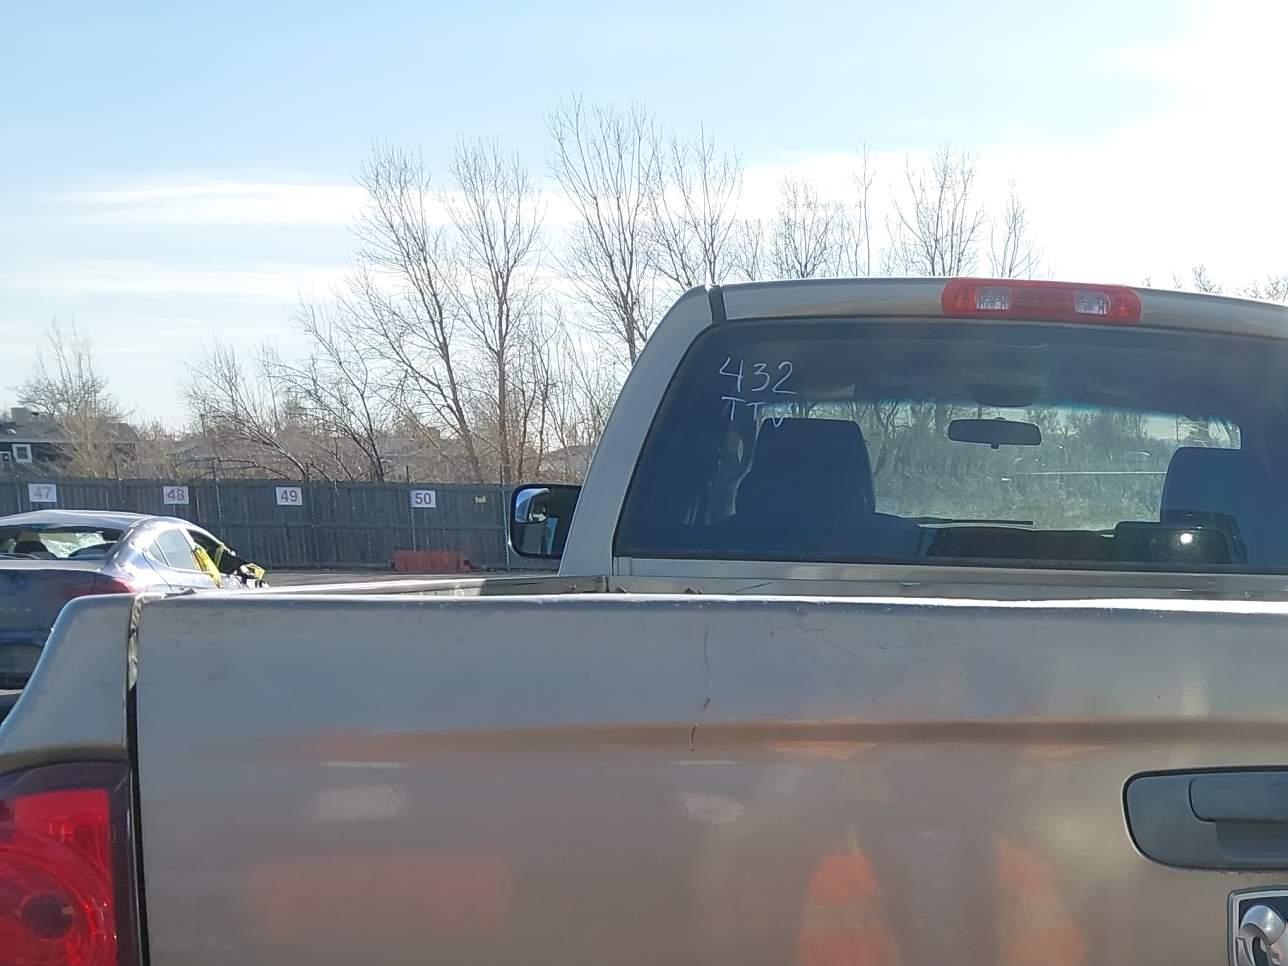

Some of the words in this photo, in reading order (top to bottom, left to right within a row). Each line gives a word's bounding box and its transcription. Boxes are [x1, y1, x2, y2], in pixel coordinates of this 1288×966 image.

[719, 356, 798, 394] 432
[32, 486, 53, 499] 47
[166, 488, 185, 501] 48
[280, 489, 298, 502] 49
[414, 492, 432, 504] 50
